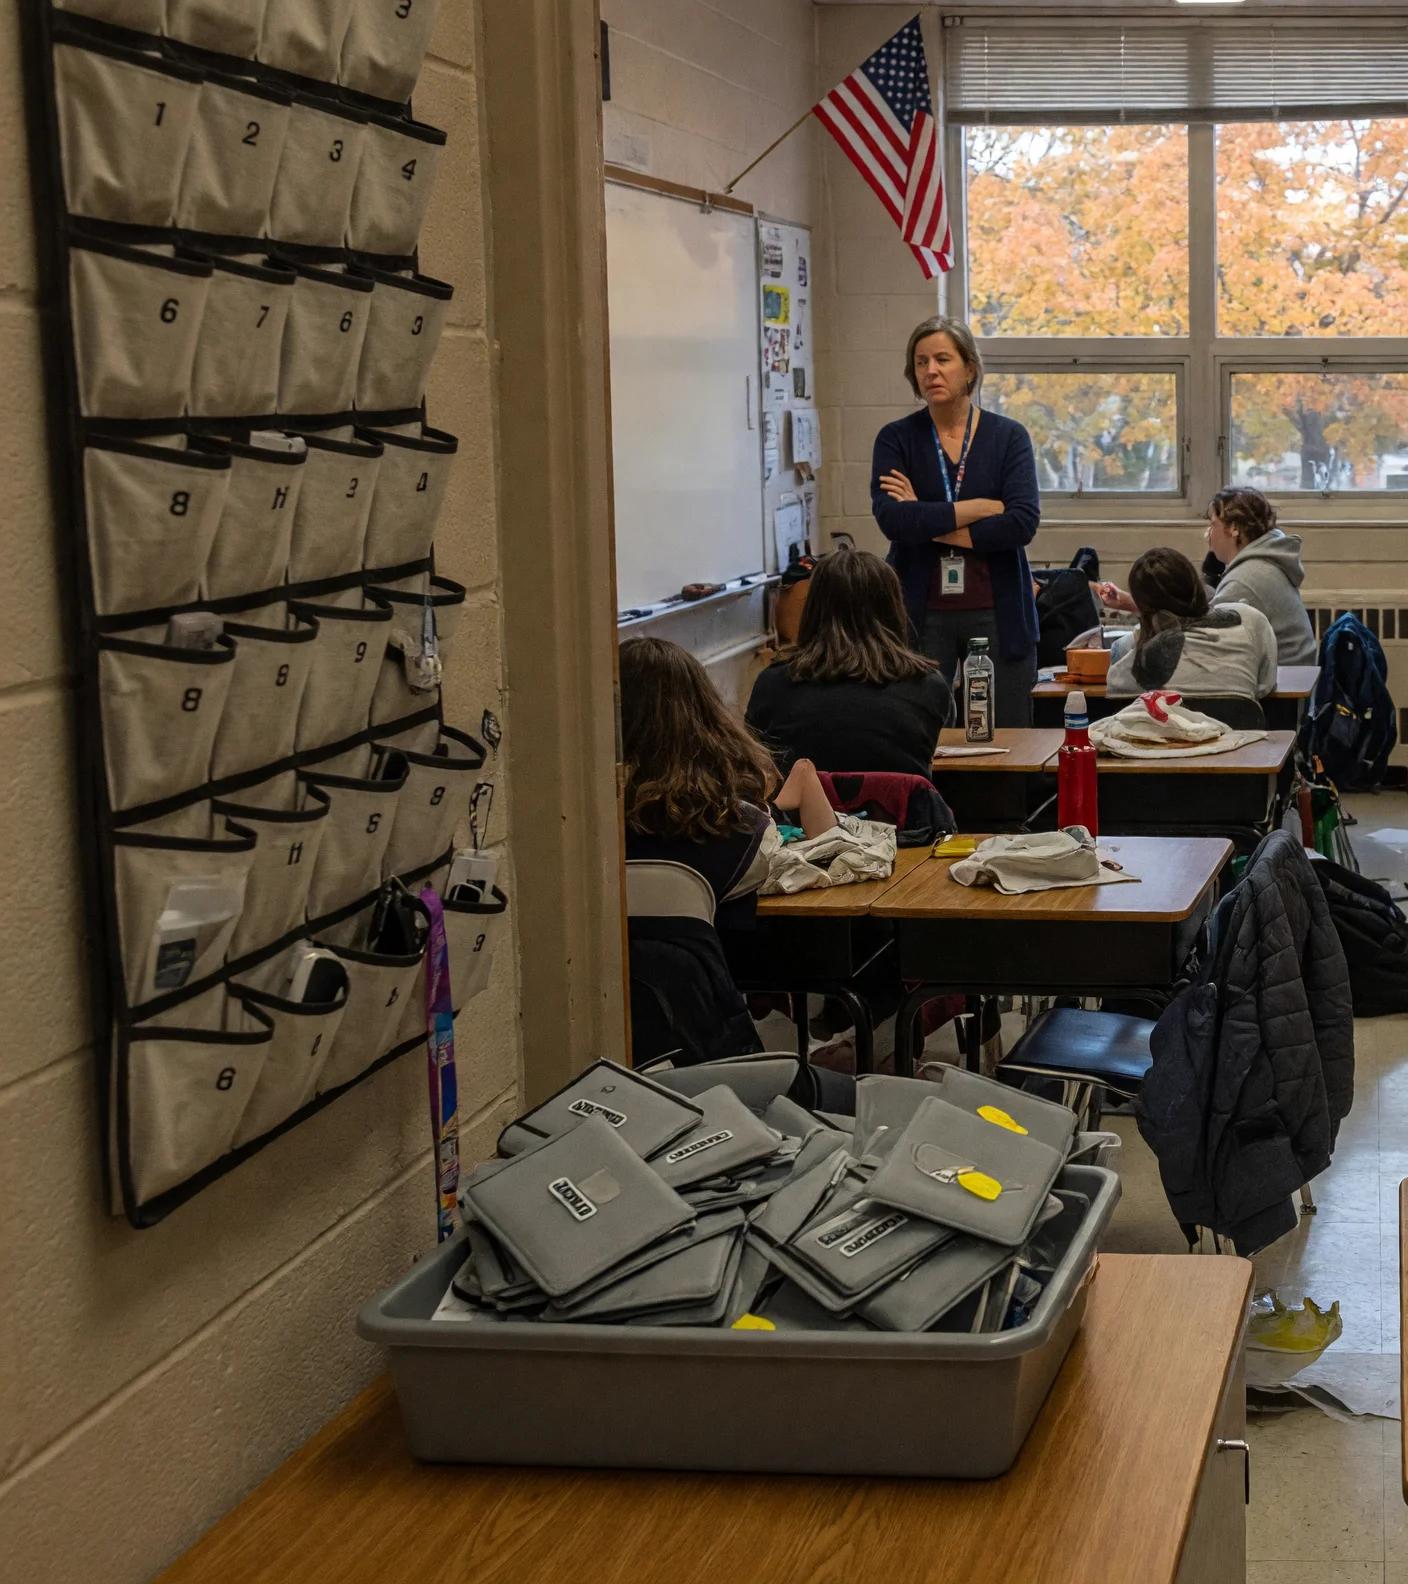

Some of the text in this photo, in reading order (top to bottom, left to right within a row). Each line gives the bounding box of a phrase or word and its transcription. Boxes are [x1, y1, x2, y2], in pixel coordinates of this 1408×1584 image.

[154, 101, 168, 127] 1
[241, 121, 261, 147] 2
[329, 139, 344, 163] 3
[160, 298, 179, 324] 6
[256, 305, 270, 329] 7
[339, 311, 353, 333] 6
[169, 491, 191, 517] 8
[354, 641, 367, 663] 9
[181, 687, 203, 713] 8
[215, 1067, 236, 1091] 6
